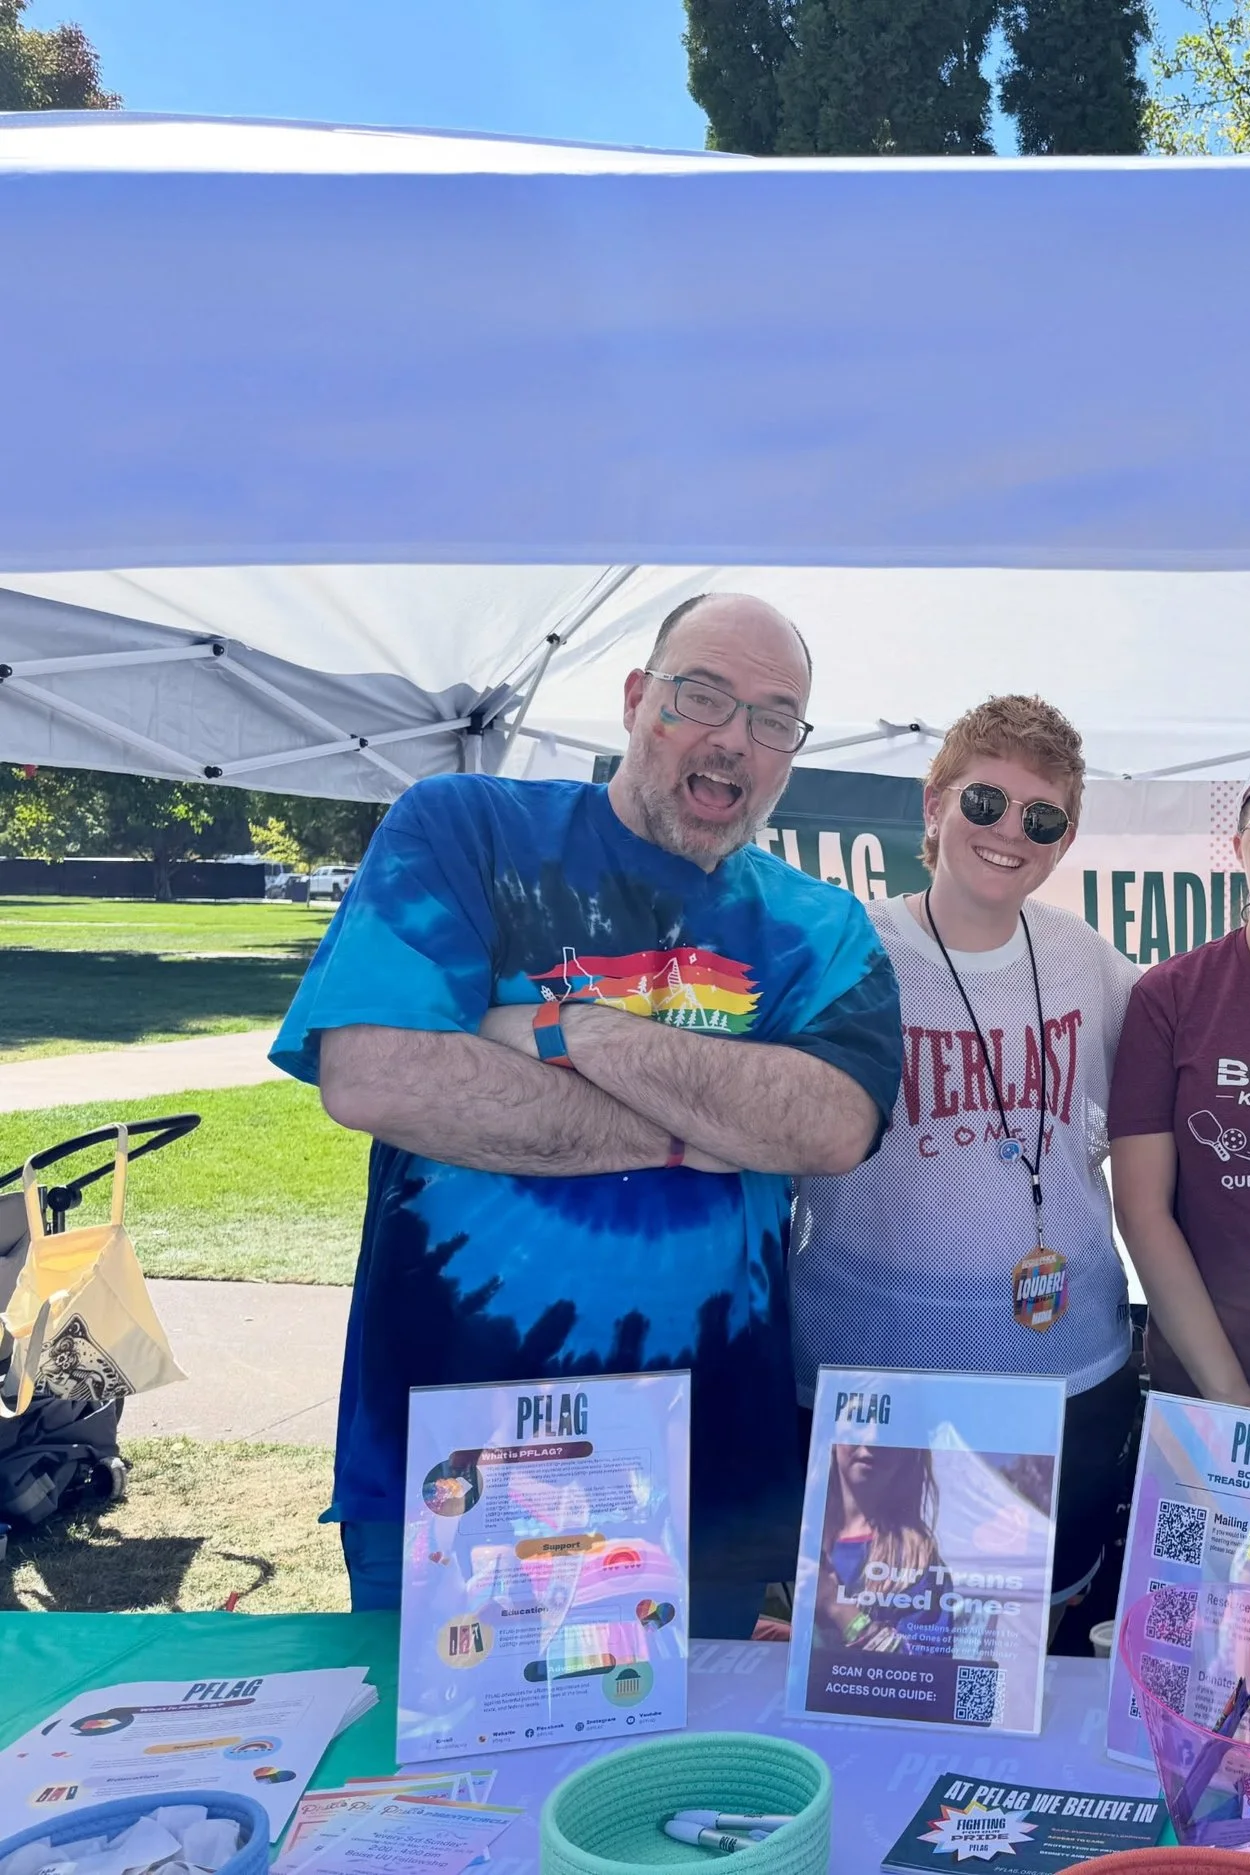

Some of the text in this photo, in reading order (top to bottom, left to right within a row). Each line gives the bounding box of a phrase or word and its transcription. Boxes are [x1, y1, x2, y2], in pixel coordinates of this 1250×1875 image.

[902, 1009, 1082, 1125] VERLAST
[1017, 1270, 1066, 1301] LOUDER!
[517, 1392, 588, 1440] PFLAG
[835, 1392, 891, 1424] PFLAG
[482, 1447, 563, 1461] What is PFLAG?
[1214, 1513, 1248, 1532] Mailing
[543, 1541, 580, 1552] Support
[864, 1561, 1024, 1590] Our Trans
[836, 1585, 1022, 1616] Loved Ones
[907, 1622, 950, 1633] Questions
[920, 1633, 941, 1643] Ones
[942, 1635, 952, 1644] of
[908, 1643, 960, 1654] Transgender
[832, 1665, 934, 1684] SCAN QR CODE TO
[182, 1679, 263, 1702] PFLAG
[825, 1683, 937, 1702] ACCESS OUR GUIDE:
[887, 1752, 1020, 1793] PFLAG
[944, 1780, 1158, 1824] AT PFLAG WE BELIEVE IN
[472, 1816, 510, 1825] CIRCLE
[957, 1818, 1006, 1830] FIGHTING
[405, 1835, 424, 1844] 3rd
[951, 1833, 1009, 1842] PRIDE
[369, 1844, 393, 1852] 2:00
[400, 1847, 424, 1856] 4:00
[969, 1844, 989, 1852] PFLAG
[345, 1850, 374, 1859] Boise
[393, 1855, 448, 1868] Fellowship
